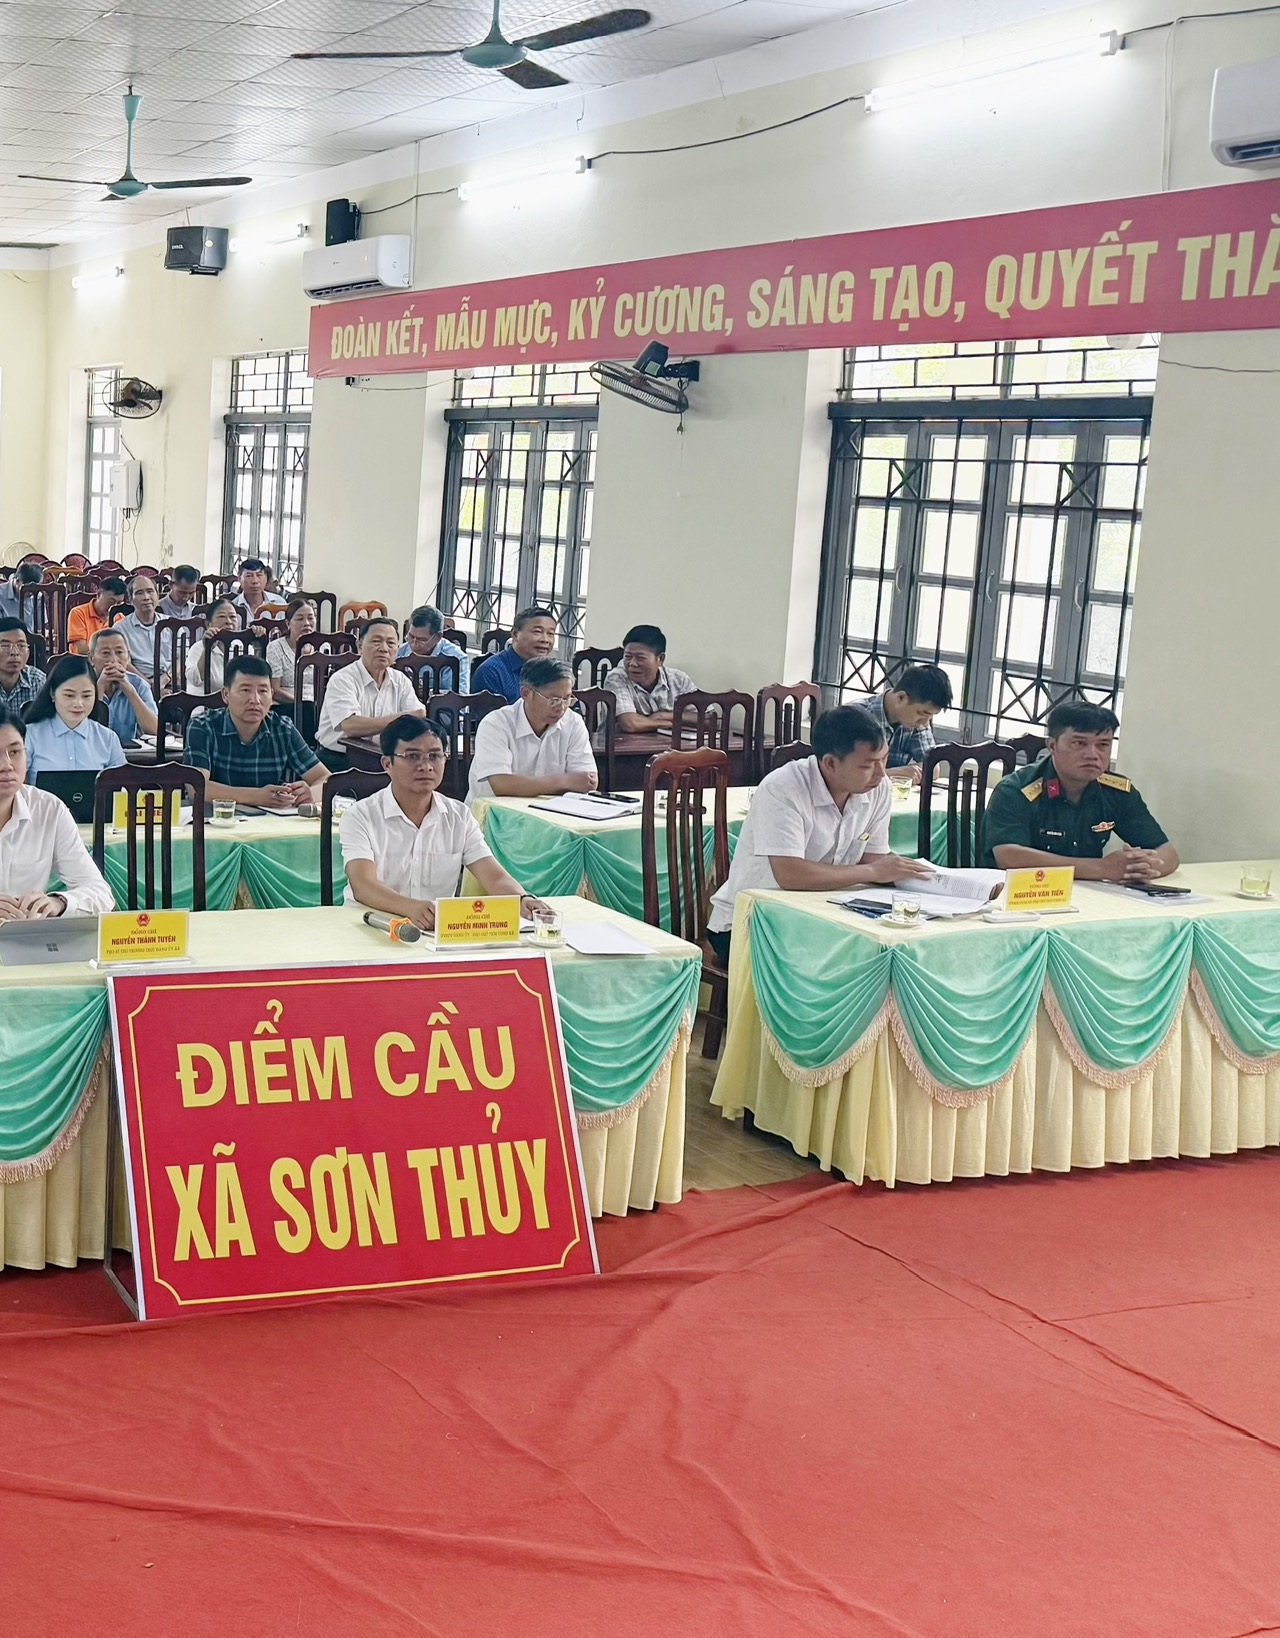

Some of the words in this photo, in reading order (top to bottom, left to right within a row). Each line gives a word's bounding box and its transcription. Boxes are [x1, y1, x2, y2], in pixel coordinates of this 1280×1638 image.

[330, 315, 381, 360] ĐOÀN
[385, 304, 427, 355] KẾT,
[434, 296, 487, 352] MẪU
[493, 298, 558, 353] MỰC,
[567, 277, 608, 341] KỶ
[613, 281, 734, 336] CƯƠNG,
[747, 265, 855, 329] SÁNG
[869, 261, 966, 332] TẠO,
[984, 220, 1159, 320] QUYẾT
[175, 999, 352, 1108] ĐIỂM
[373, 1001, 516, 1096] CẦU
[165, 1141, 257, 1261] XÃ
[269, 1146, 398, 1254] SƠN
[407, 1101, 550, 1242] THỦY
